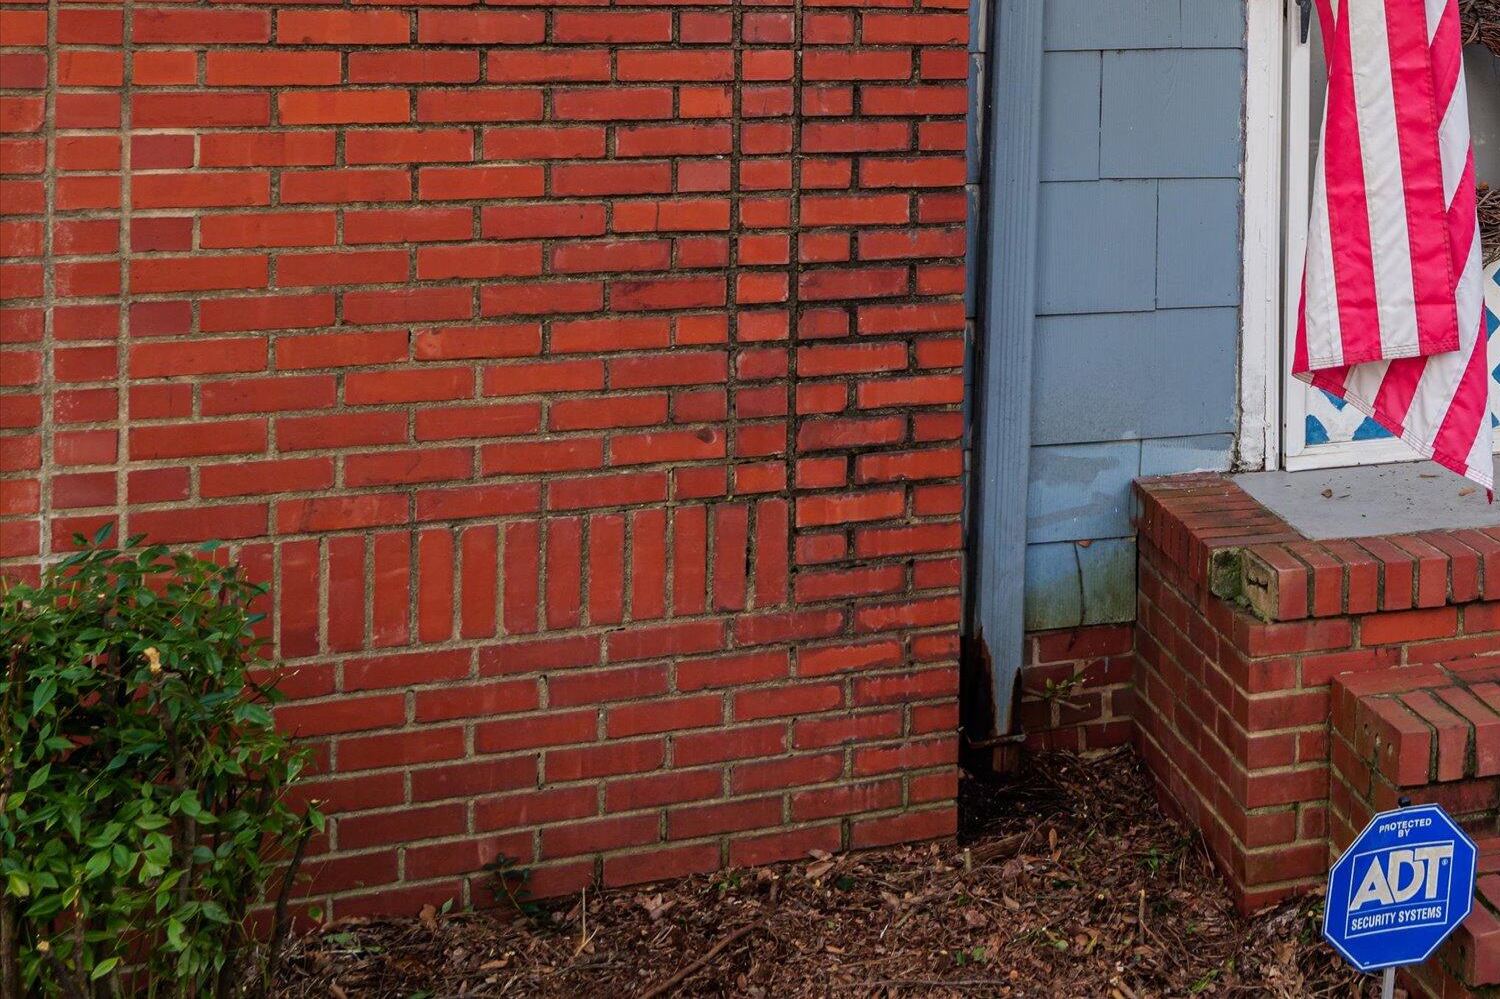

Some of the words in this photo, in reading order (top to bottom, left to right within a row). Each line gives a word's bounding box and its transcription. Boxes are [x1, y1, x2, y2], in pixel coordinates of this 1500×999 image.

[1379, 818, 1432, 833] PROTECTED
[1397, 829, 1410, 838] BY
[1349, 844, 1453, 912] ADT
[1351, 912, 1396, 932] SECURITY
[1398, 906, 1442, 923] SYSTEMS
